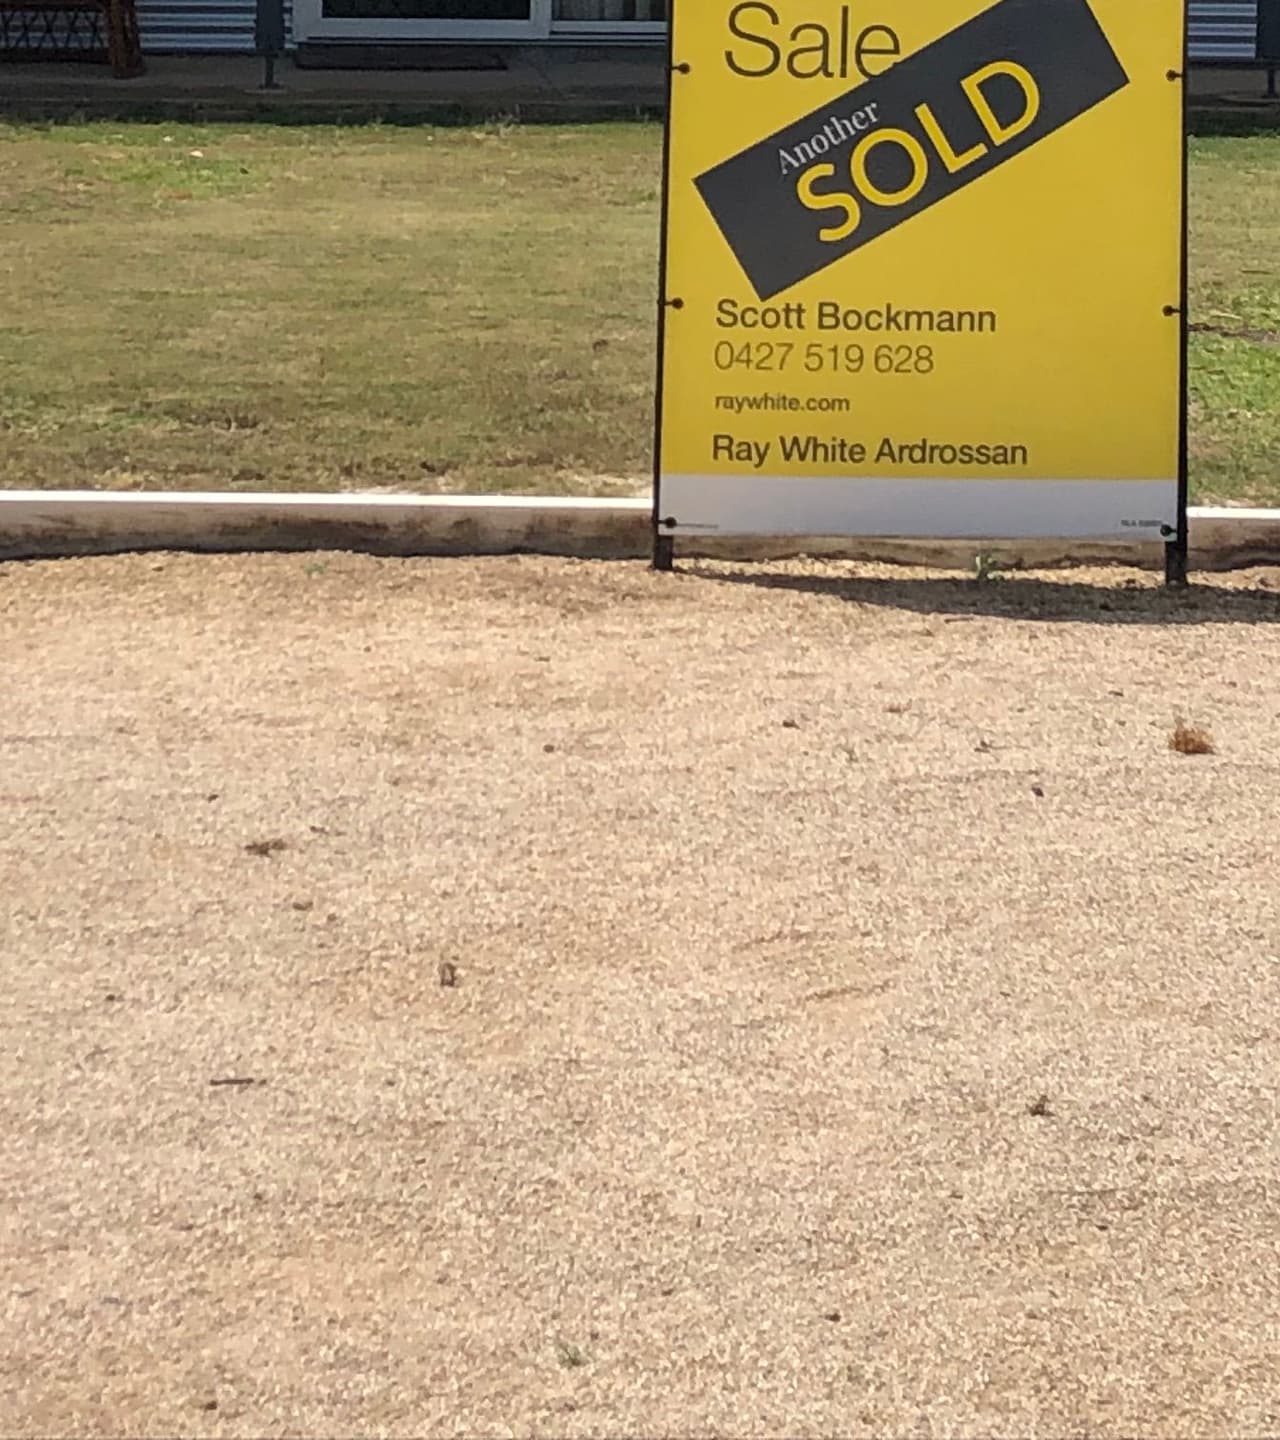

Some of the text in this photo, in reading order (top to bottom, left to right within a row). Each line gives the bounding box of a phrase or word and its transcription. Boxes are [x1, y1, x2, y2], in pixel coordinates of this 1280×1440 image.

[724, 1, 901, 80] Sale
[777, 102, 879, 175] Another
[796, 59, 1041, 243] SOLD
[715, 298, 997, 333] Scott Bockmann
[714, 340, 934, 374] 0427 519 628
[714, 392, 851, 414] raywhite.com
[712, 433, 1028, 469] Ray White Ardrossan
